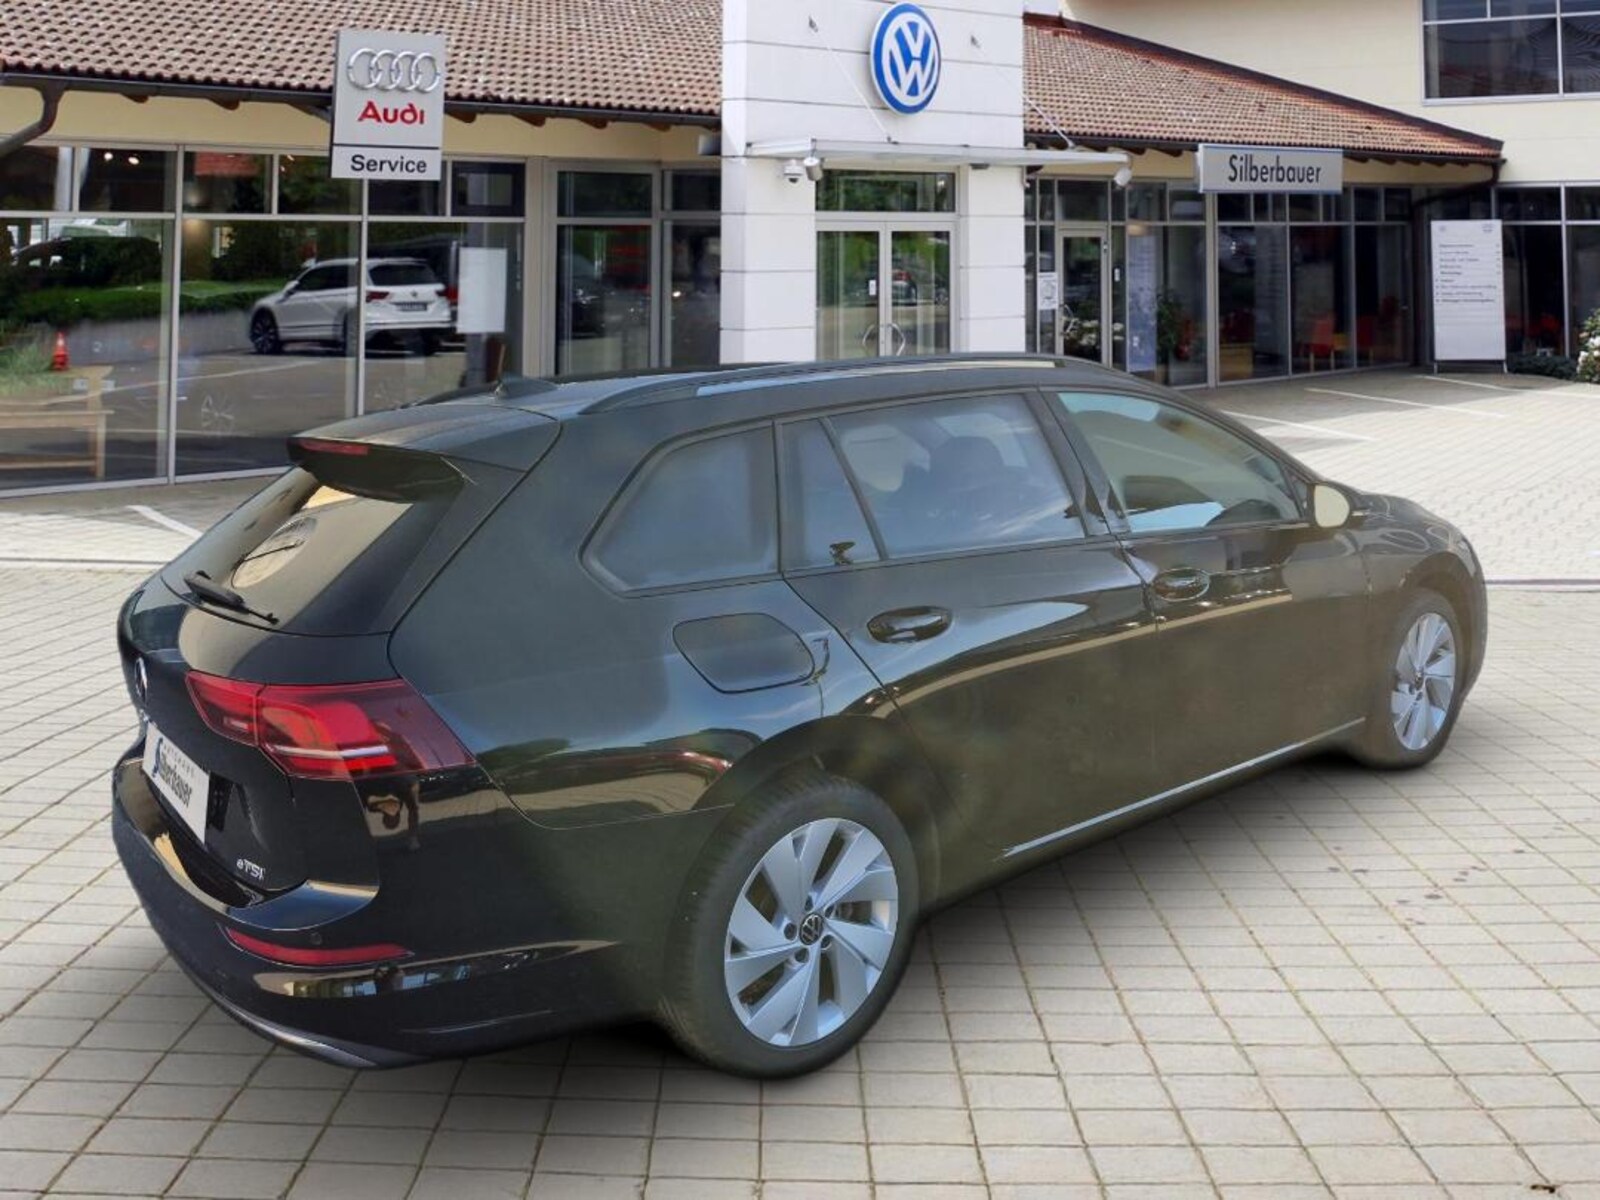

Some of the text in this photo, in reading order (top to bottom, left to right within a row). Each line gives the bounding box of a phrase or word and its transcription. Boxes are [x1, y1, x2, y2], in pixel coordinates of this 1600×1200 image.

[878, 8, 939, 109] VW
[357, 100, 425, 125] Audi
[351, 153, 427, 173] Service
[1228, 153, 1321, 183] Silberbauer
